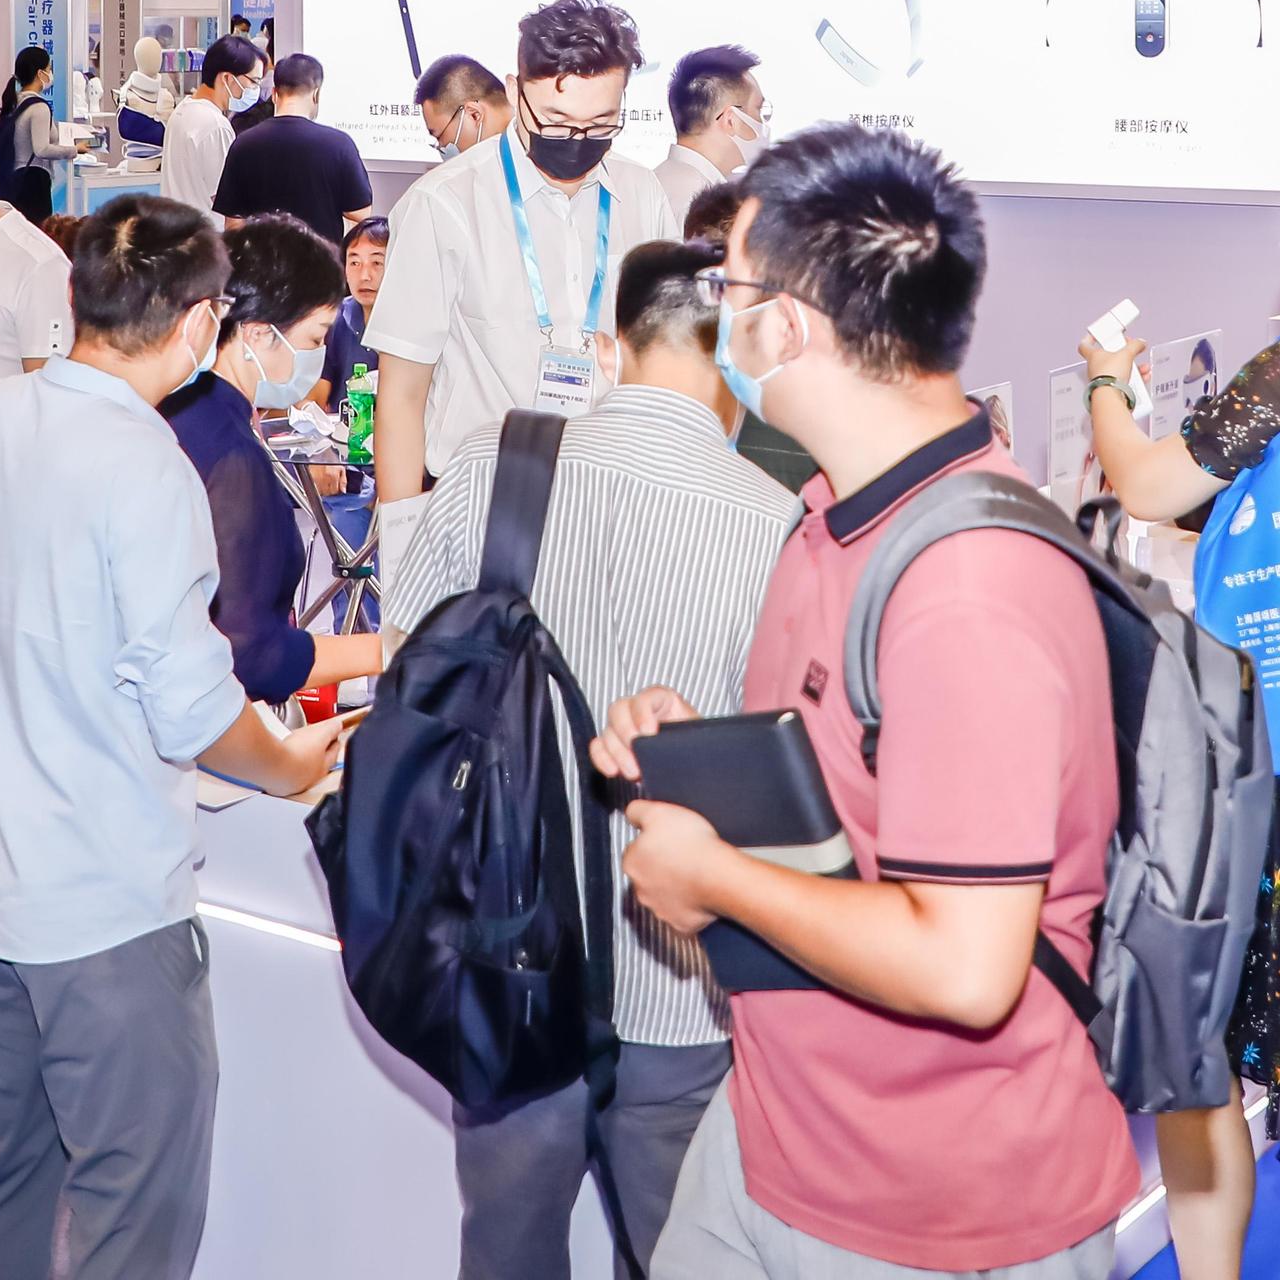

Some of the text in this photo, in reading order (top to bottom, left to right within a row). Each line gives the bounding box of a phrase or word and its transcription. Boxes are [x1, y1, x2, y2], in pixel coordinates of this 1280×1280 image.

[1114, 118, 1190, 134] 腰部按摩仪
